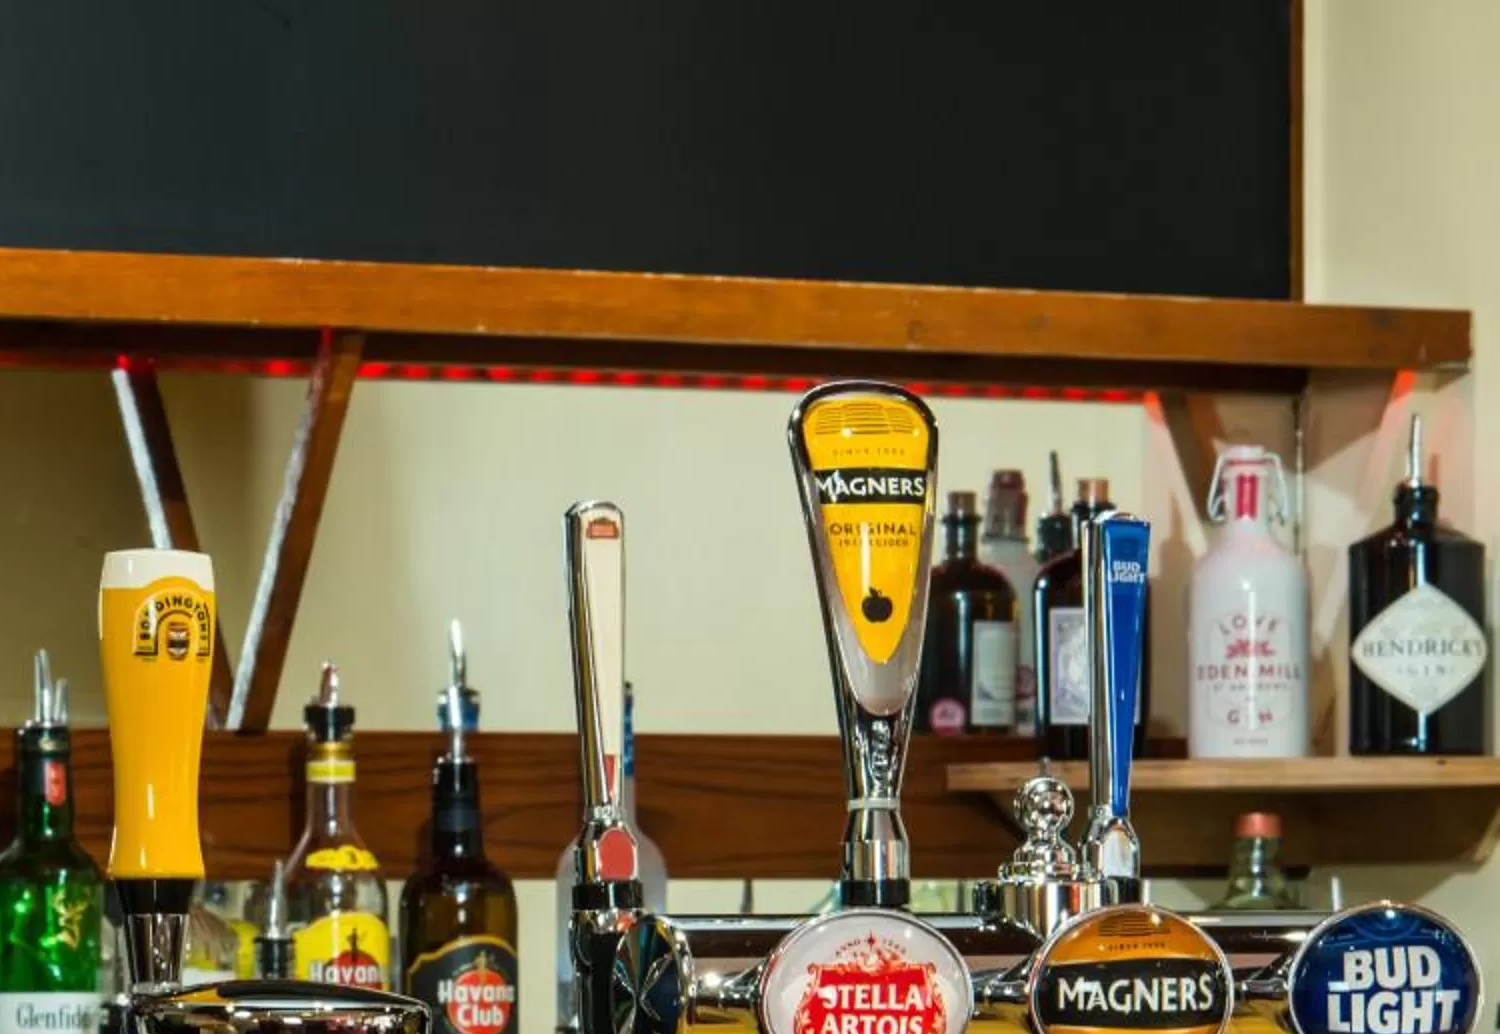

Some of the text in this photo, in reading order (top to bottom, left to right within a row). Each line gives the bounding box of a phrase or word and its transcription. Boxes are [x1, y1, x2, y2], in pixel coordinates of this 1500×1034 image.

[815, 475, 924, 497] MAGNERS
[1227, 708, 1274, 724] GN
[308, 961, 382, 984] Havan
[1342, 944, 1442, 992] BUD
[820, 983, 925, 1011] STELLA
[1057, 974, 1214, 1014] MAGNERS
[456, 1003, 504, 1027] Club
